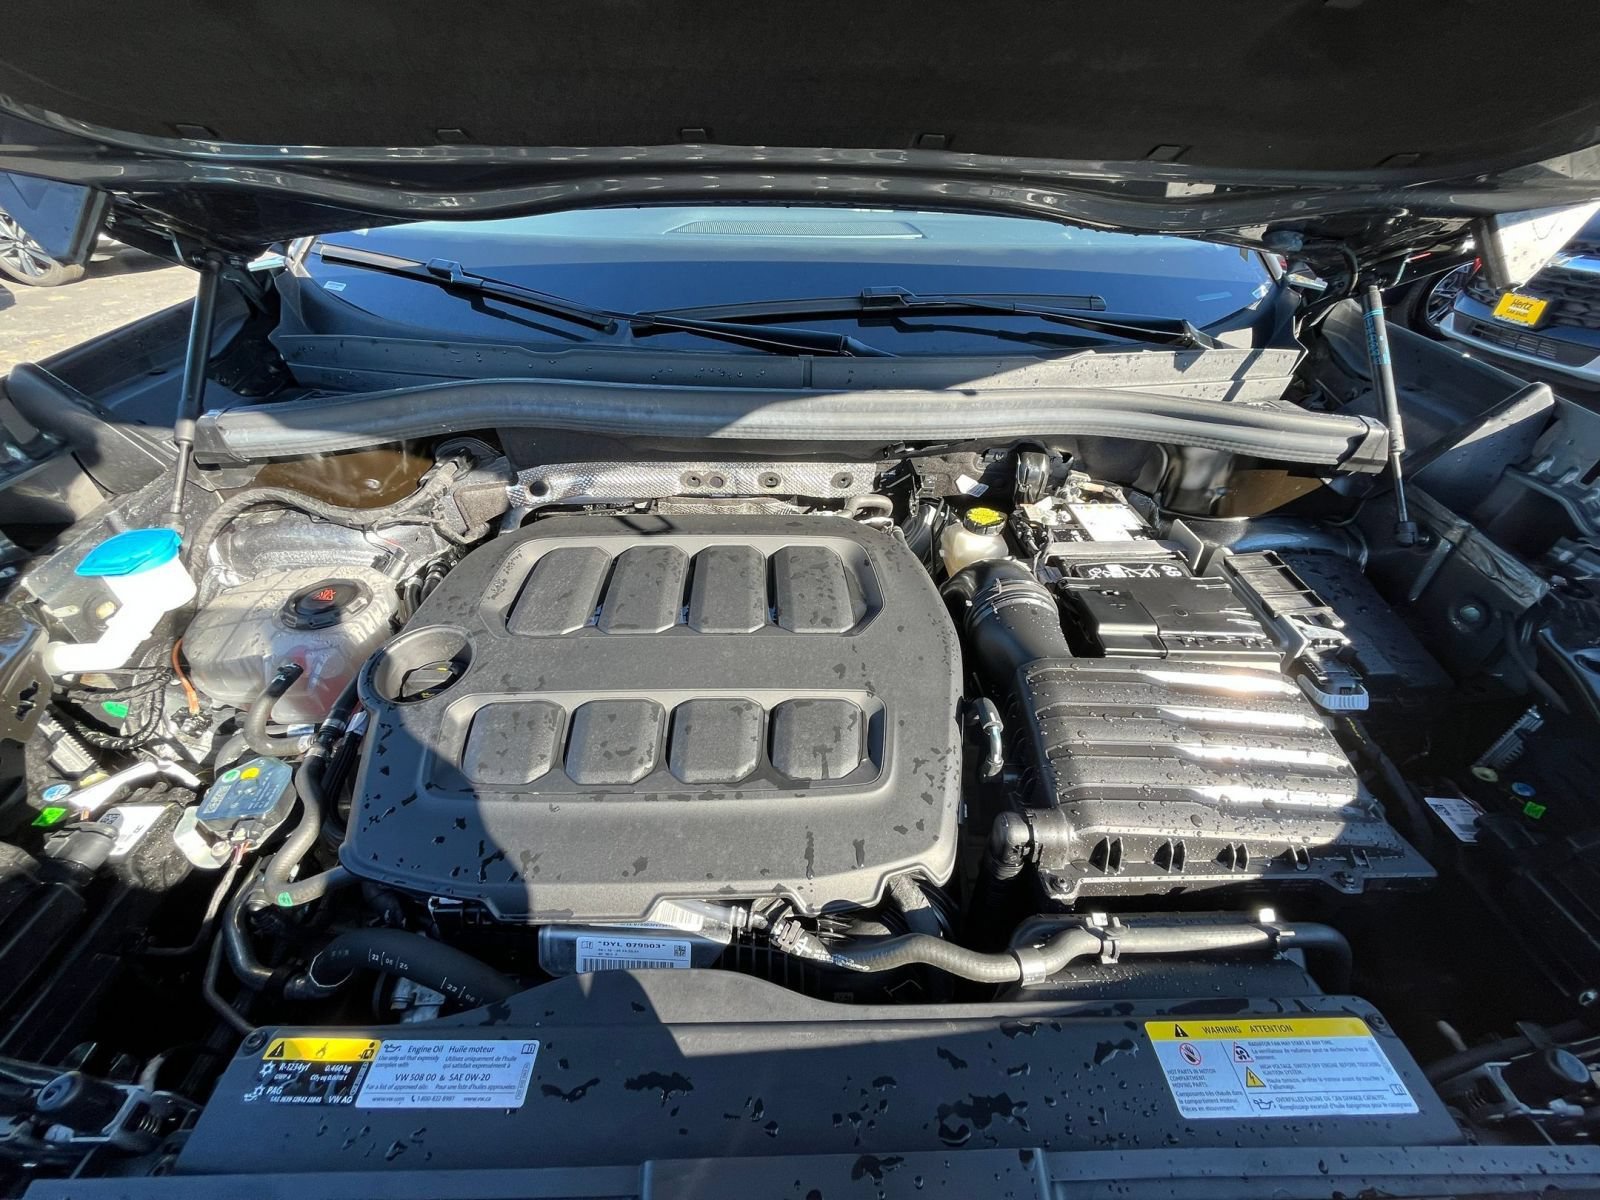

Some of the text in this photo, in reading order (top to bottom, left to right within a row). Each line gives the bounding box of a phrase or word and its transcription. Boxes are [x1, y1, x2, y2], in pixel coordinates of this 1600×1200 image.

[1510, 298, 1534, 311] Hertz
[1202, 1024, 1293, 1034] WARNING ATTENTION
[408, 1044, 443, 1054] Engine Oil
[464, 1073, 491, 1081] 0W-20
[266, 1086, 283, 1094] PAG
[340, 1096, 352, 1104] AG
